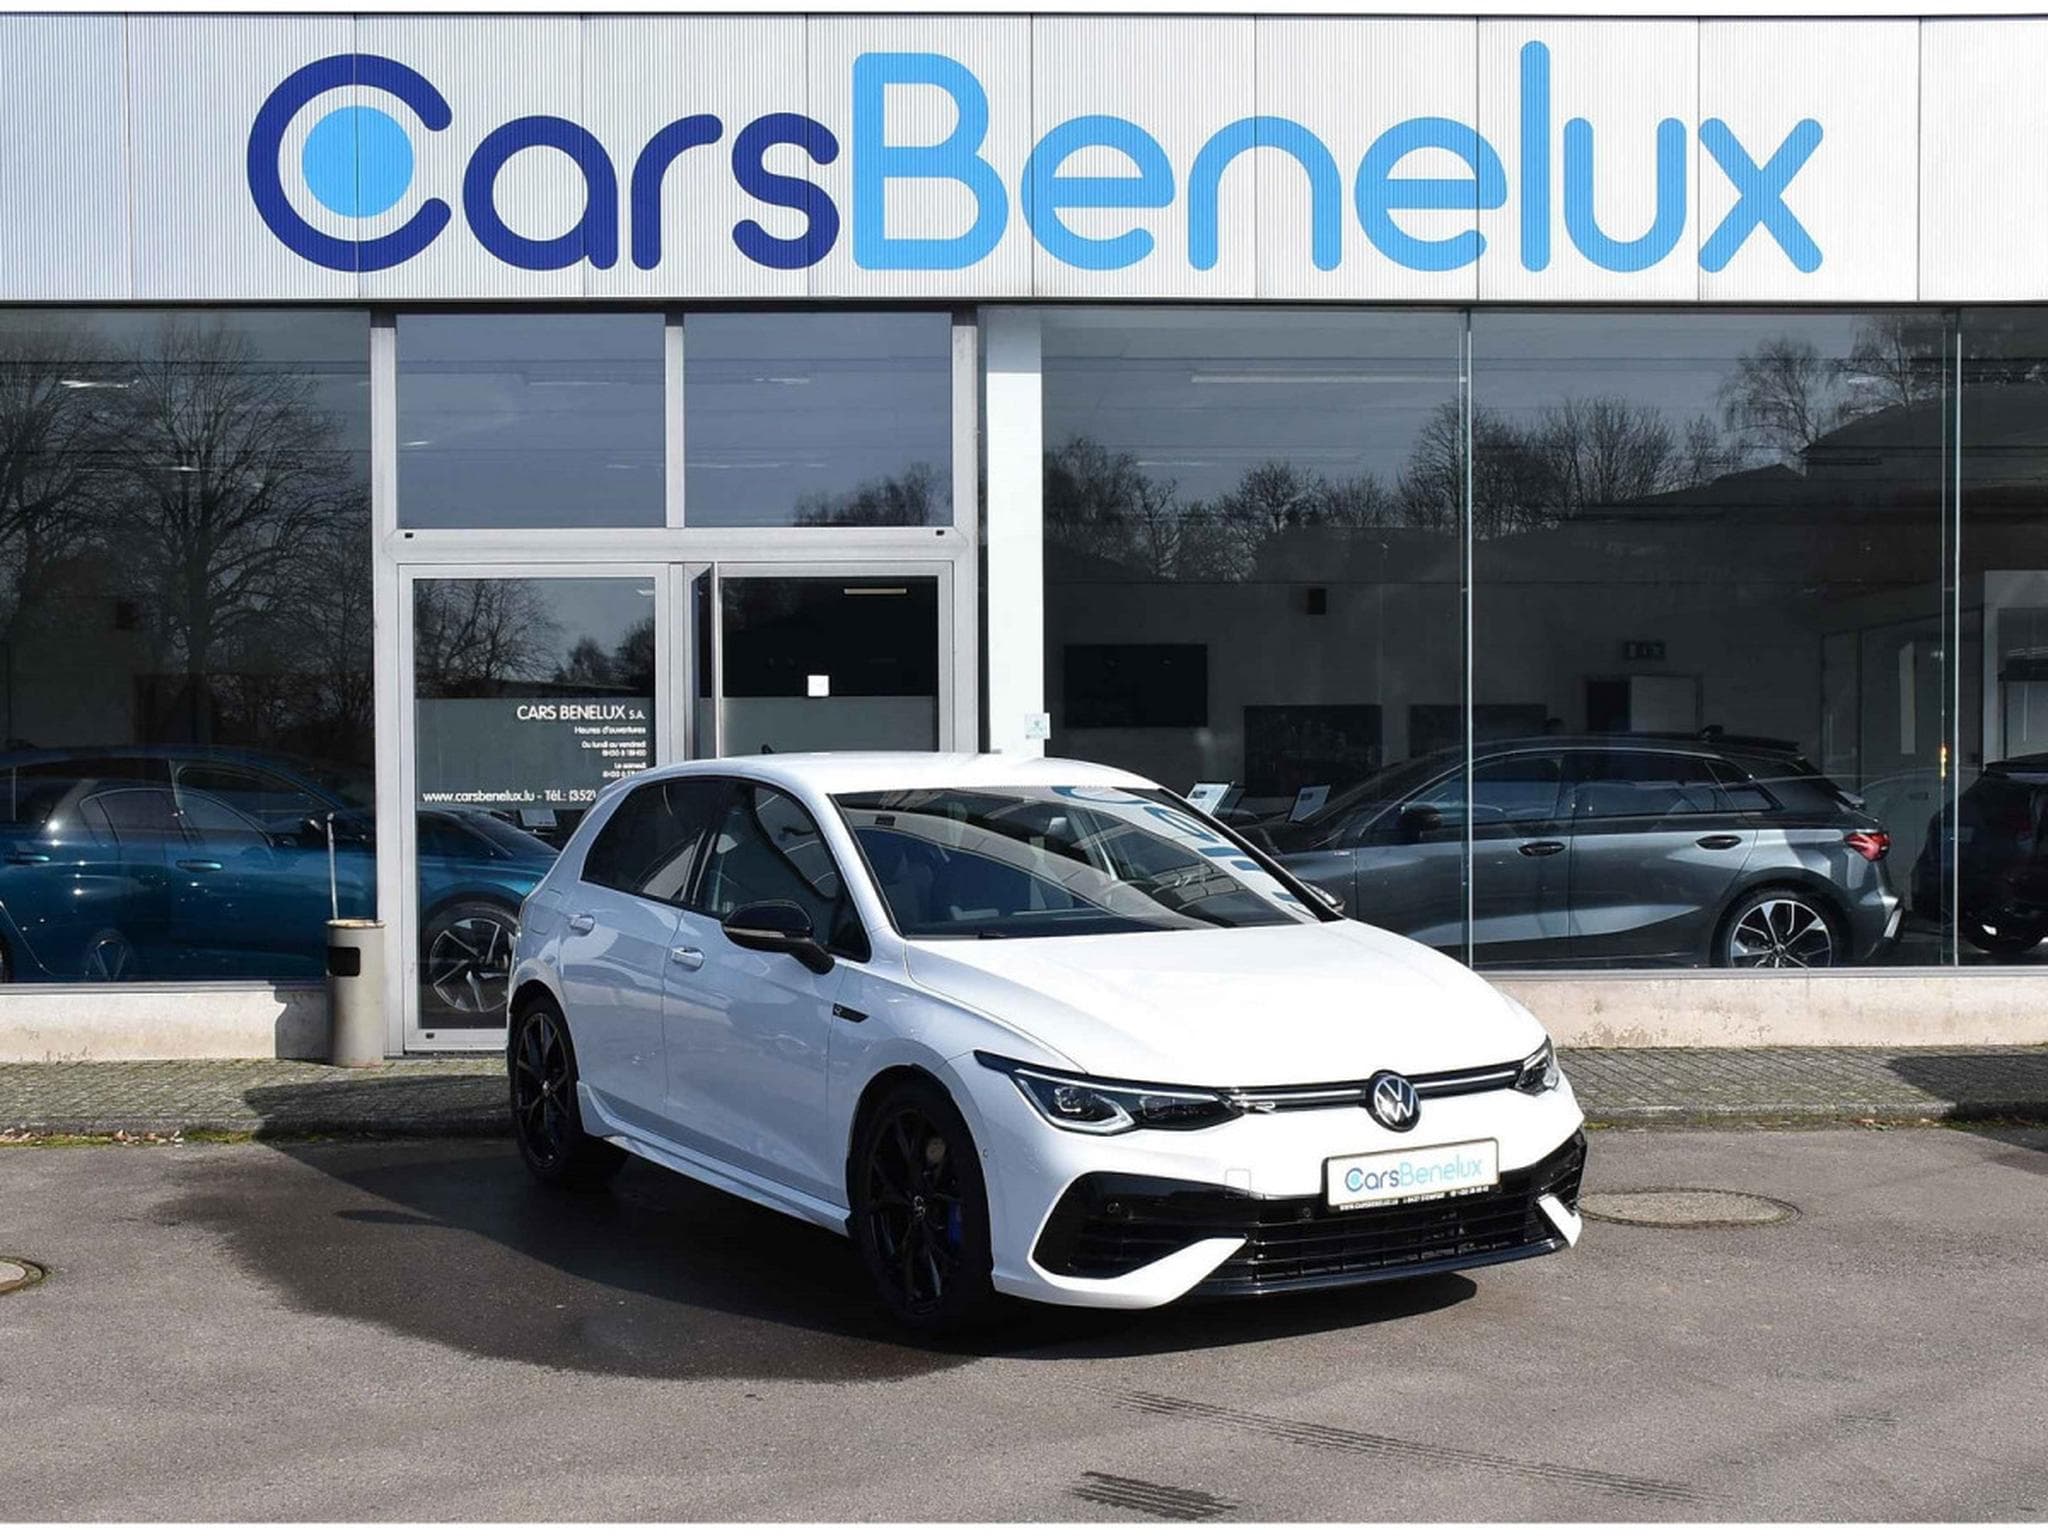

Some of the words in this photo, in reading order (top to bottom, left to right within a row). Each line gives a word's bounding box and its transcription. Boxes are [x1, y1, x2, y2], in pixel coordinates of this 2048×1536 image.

[246, 40, 1824, 272] CarsBenelux
[517, 705, 557, 720] CARS
[559, 705, 626, 720] BENELUX
[574, 725, 601, 735] Heures
[422, 789, 535, 802] www.carsbenelux.lu
[1344, 1154, 1483, 1193] CarsBenelux
